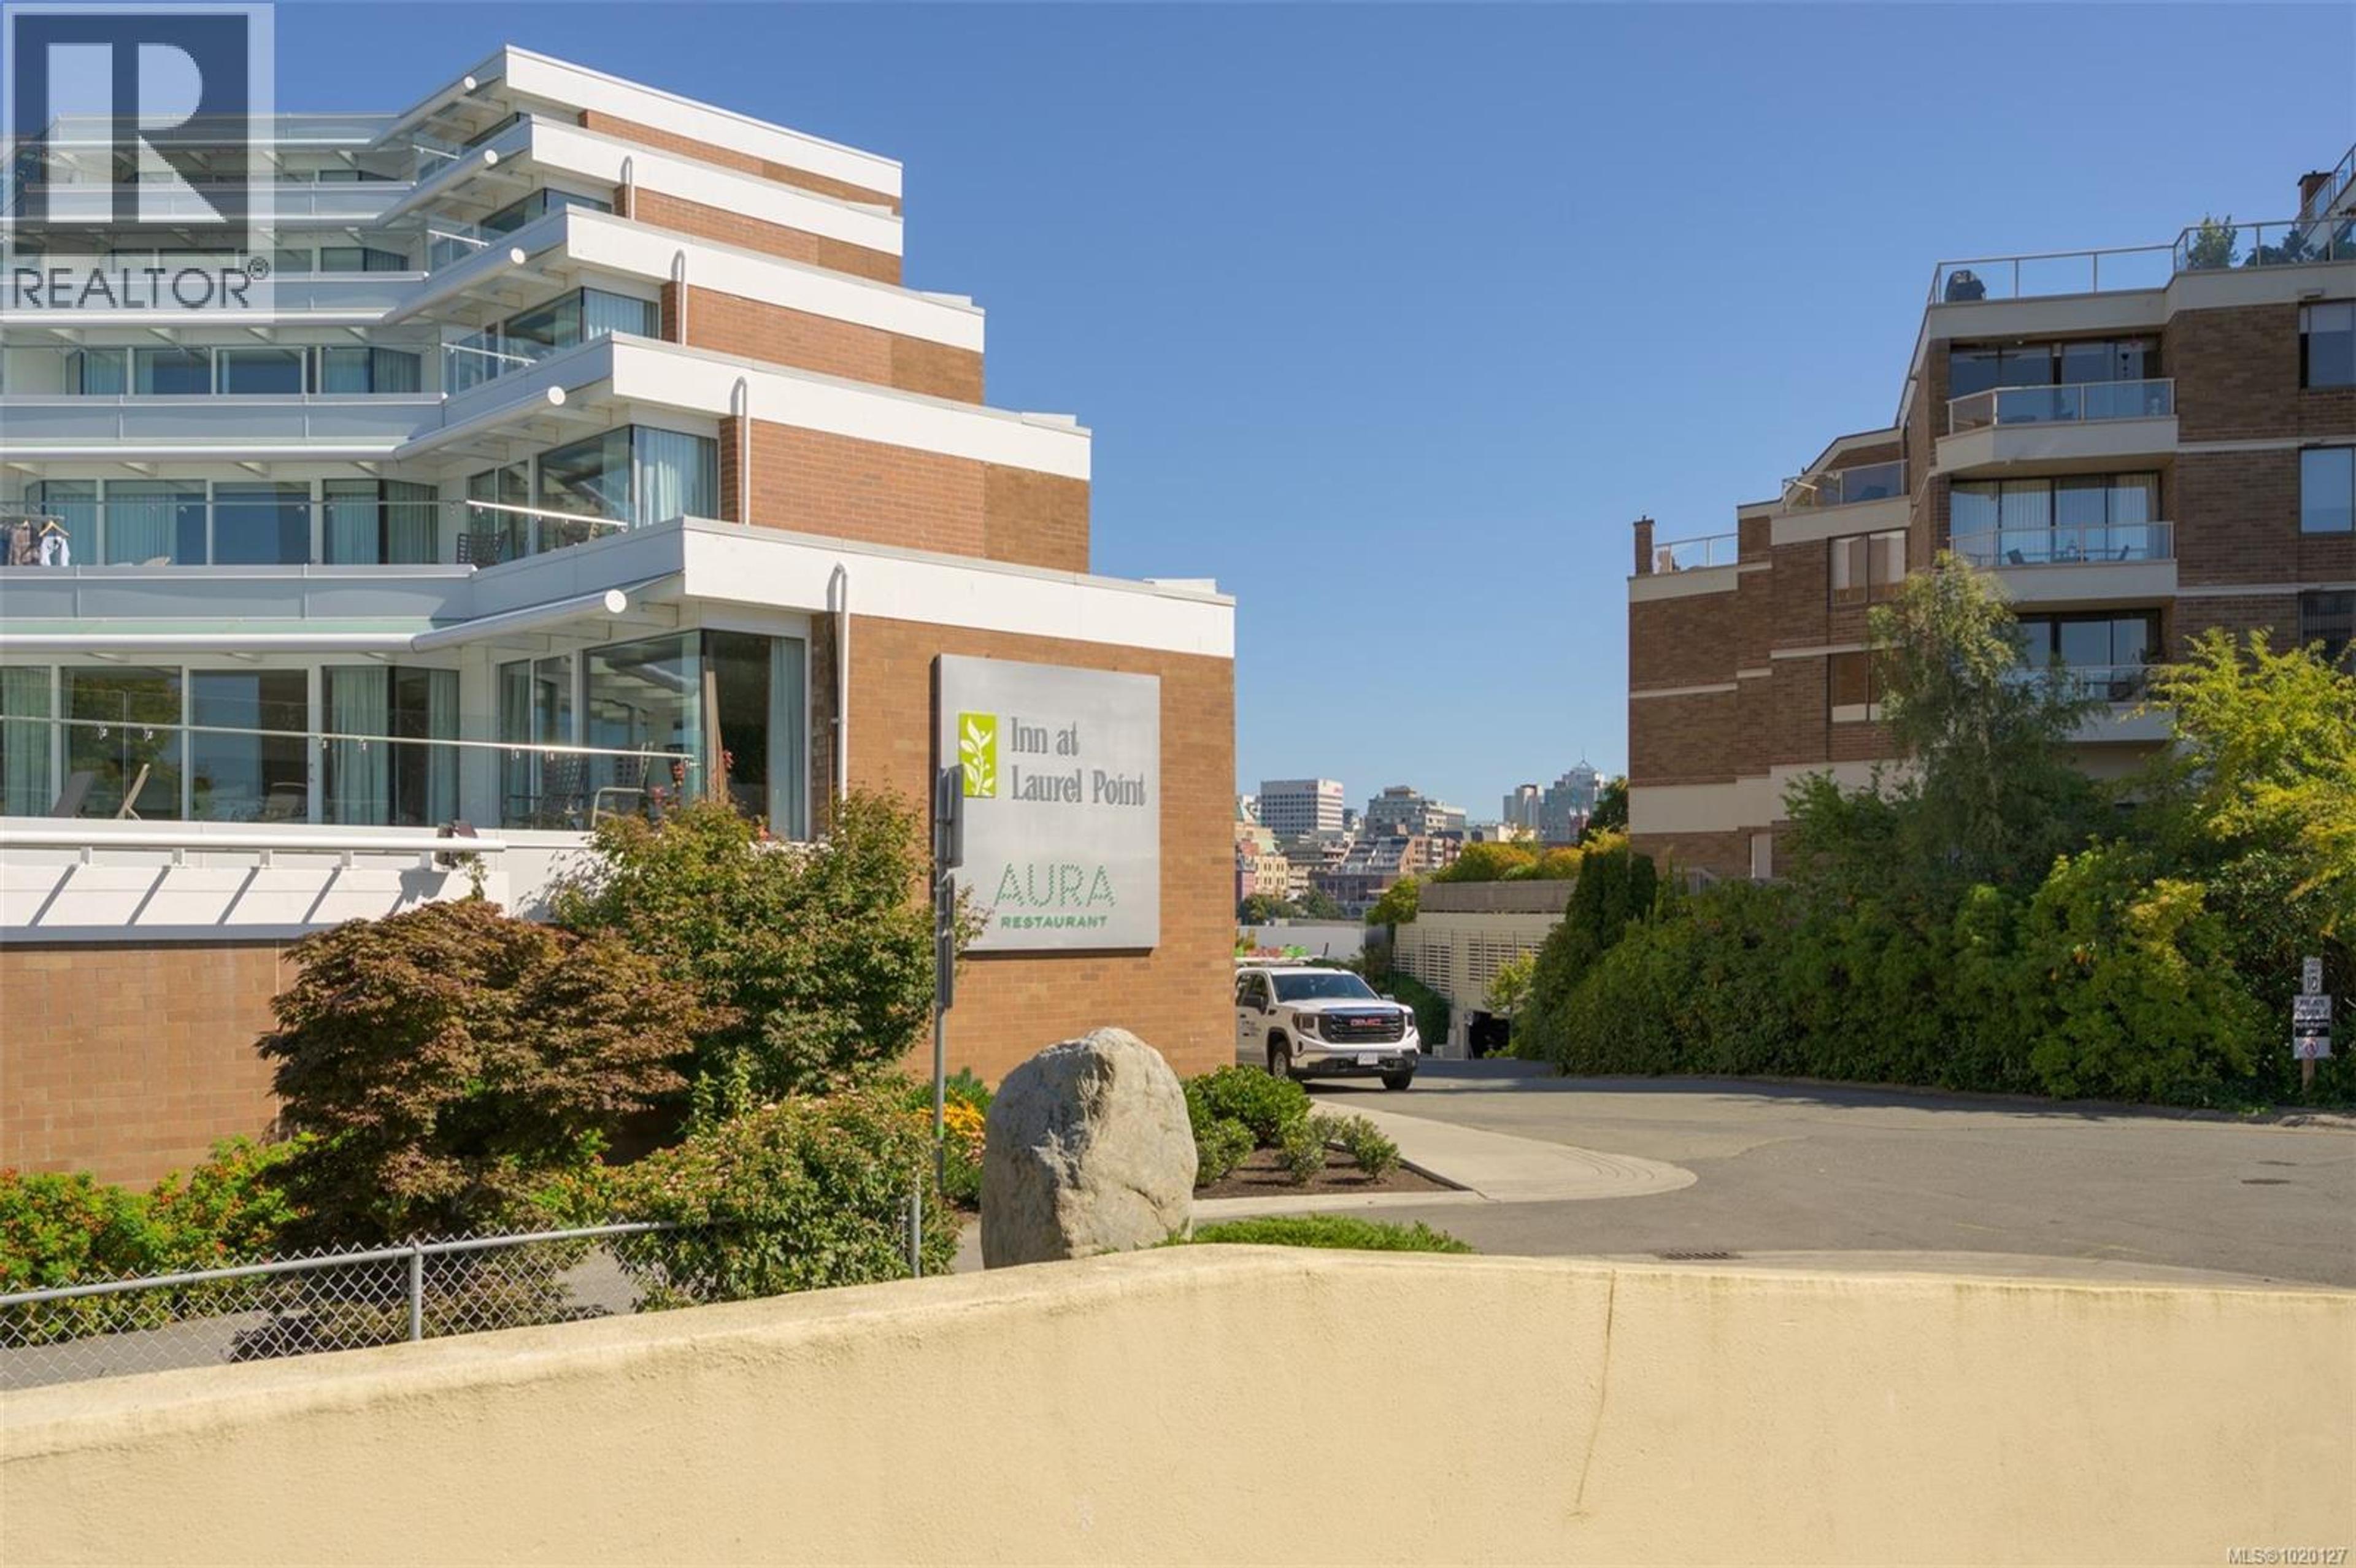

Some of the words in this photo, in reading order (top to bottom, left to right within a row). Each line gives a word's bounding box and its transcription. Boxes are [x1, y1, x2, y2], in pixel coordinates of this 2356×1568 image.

[1011, 717, 1048, 754] Inn
[1056, 721, 1079, 756] at
[1011, 765, 1082, 802] Laurel
[1093, 771, 1145, 806] Point
[995, 863, 1115, 907] AURA
[1001, 916, 1107, 929] RESTAURANT
